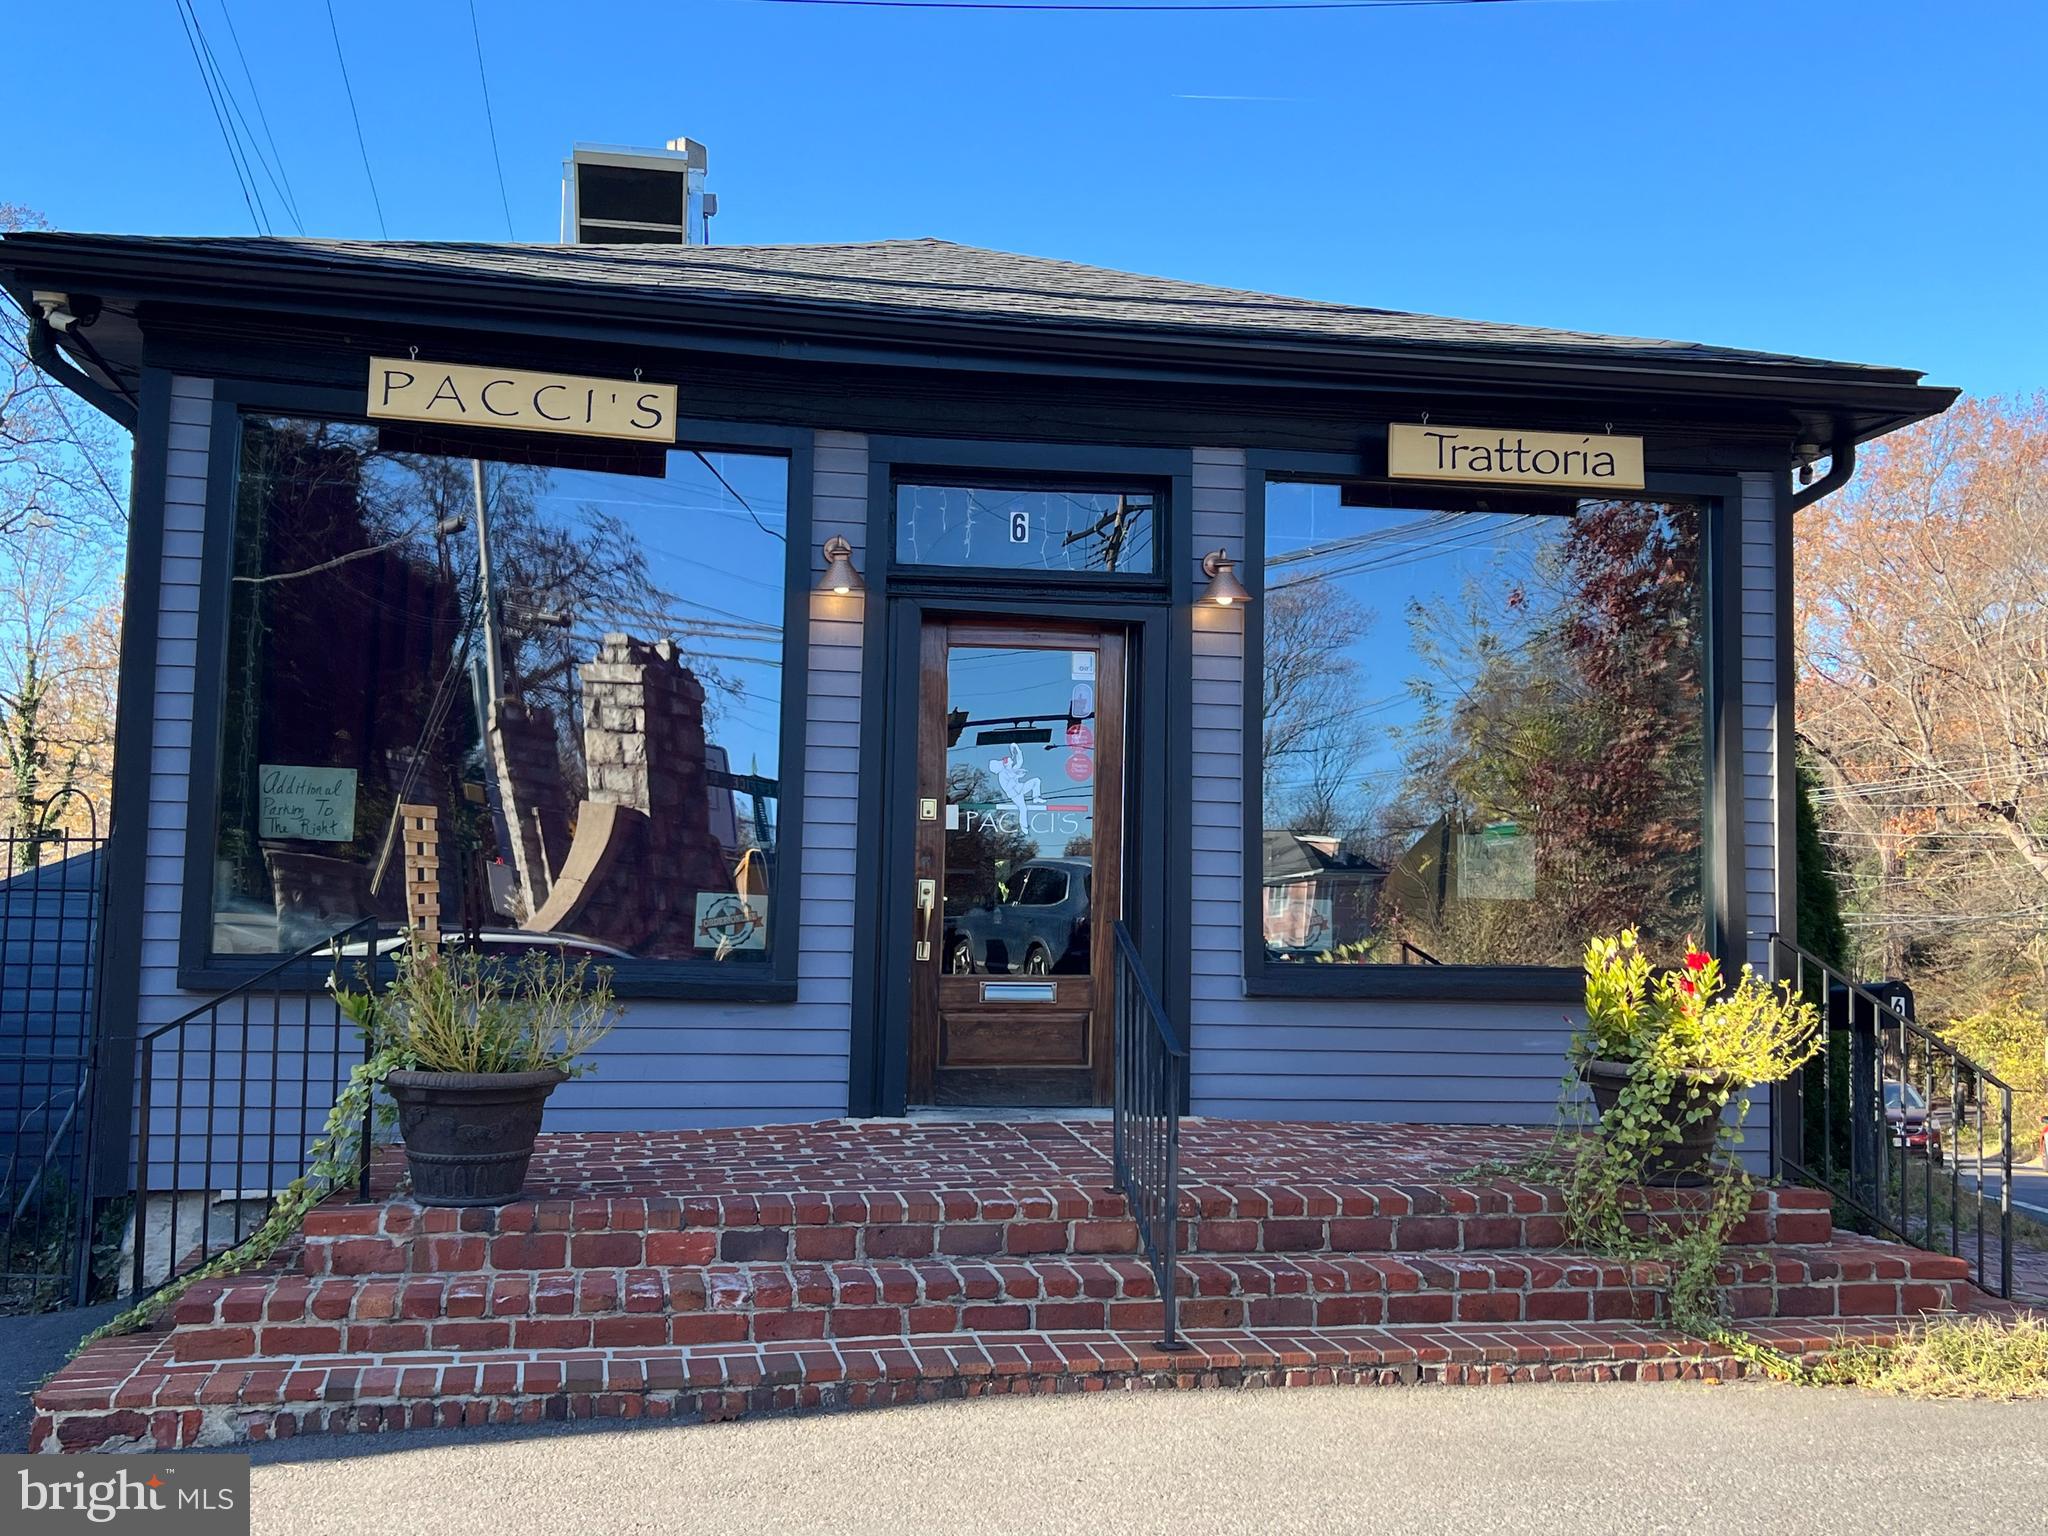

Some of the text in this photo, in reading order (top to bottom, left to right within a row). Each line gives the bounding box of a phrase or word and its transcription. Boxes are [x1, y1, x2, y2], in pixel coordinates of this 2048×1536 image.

[383, 370, 662, 429] PACCI'S
[1012, 513, 1026, 541] 6
[263, 771, 343, 796] Additional
[263, 797, 334, 820] Parking To
[263, 817, 338, 836] The Right
[966, 811, 1079, 834] PACCI'S
[1893, 998, 1903, 1015] 6
